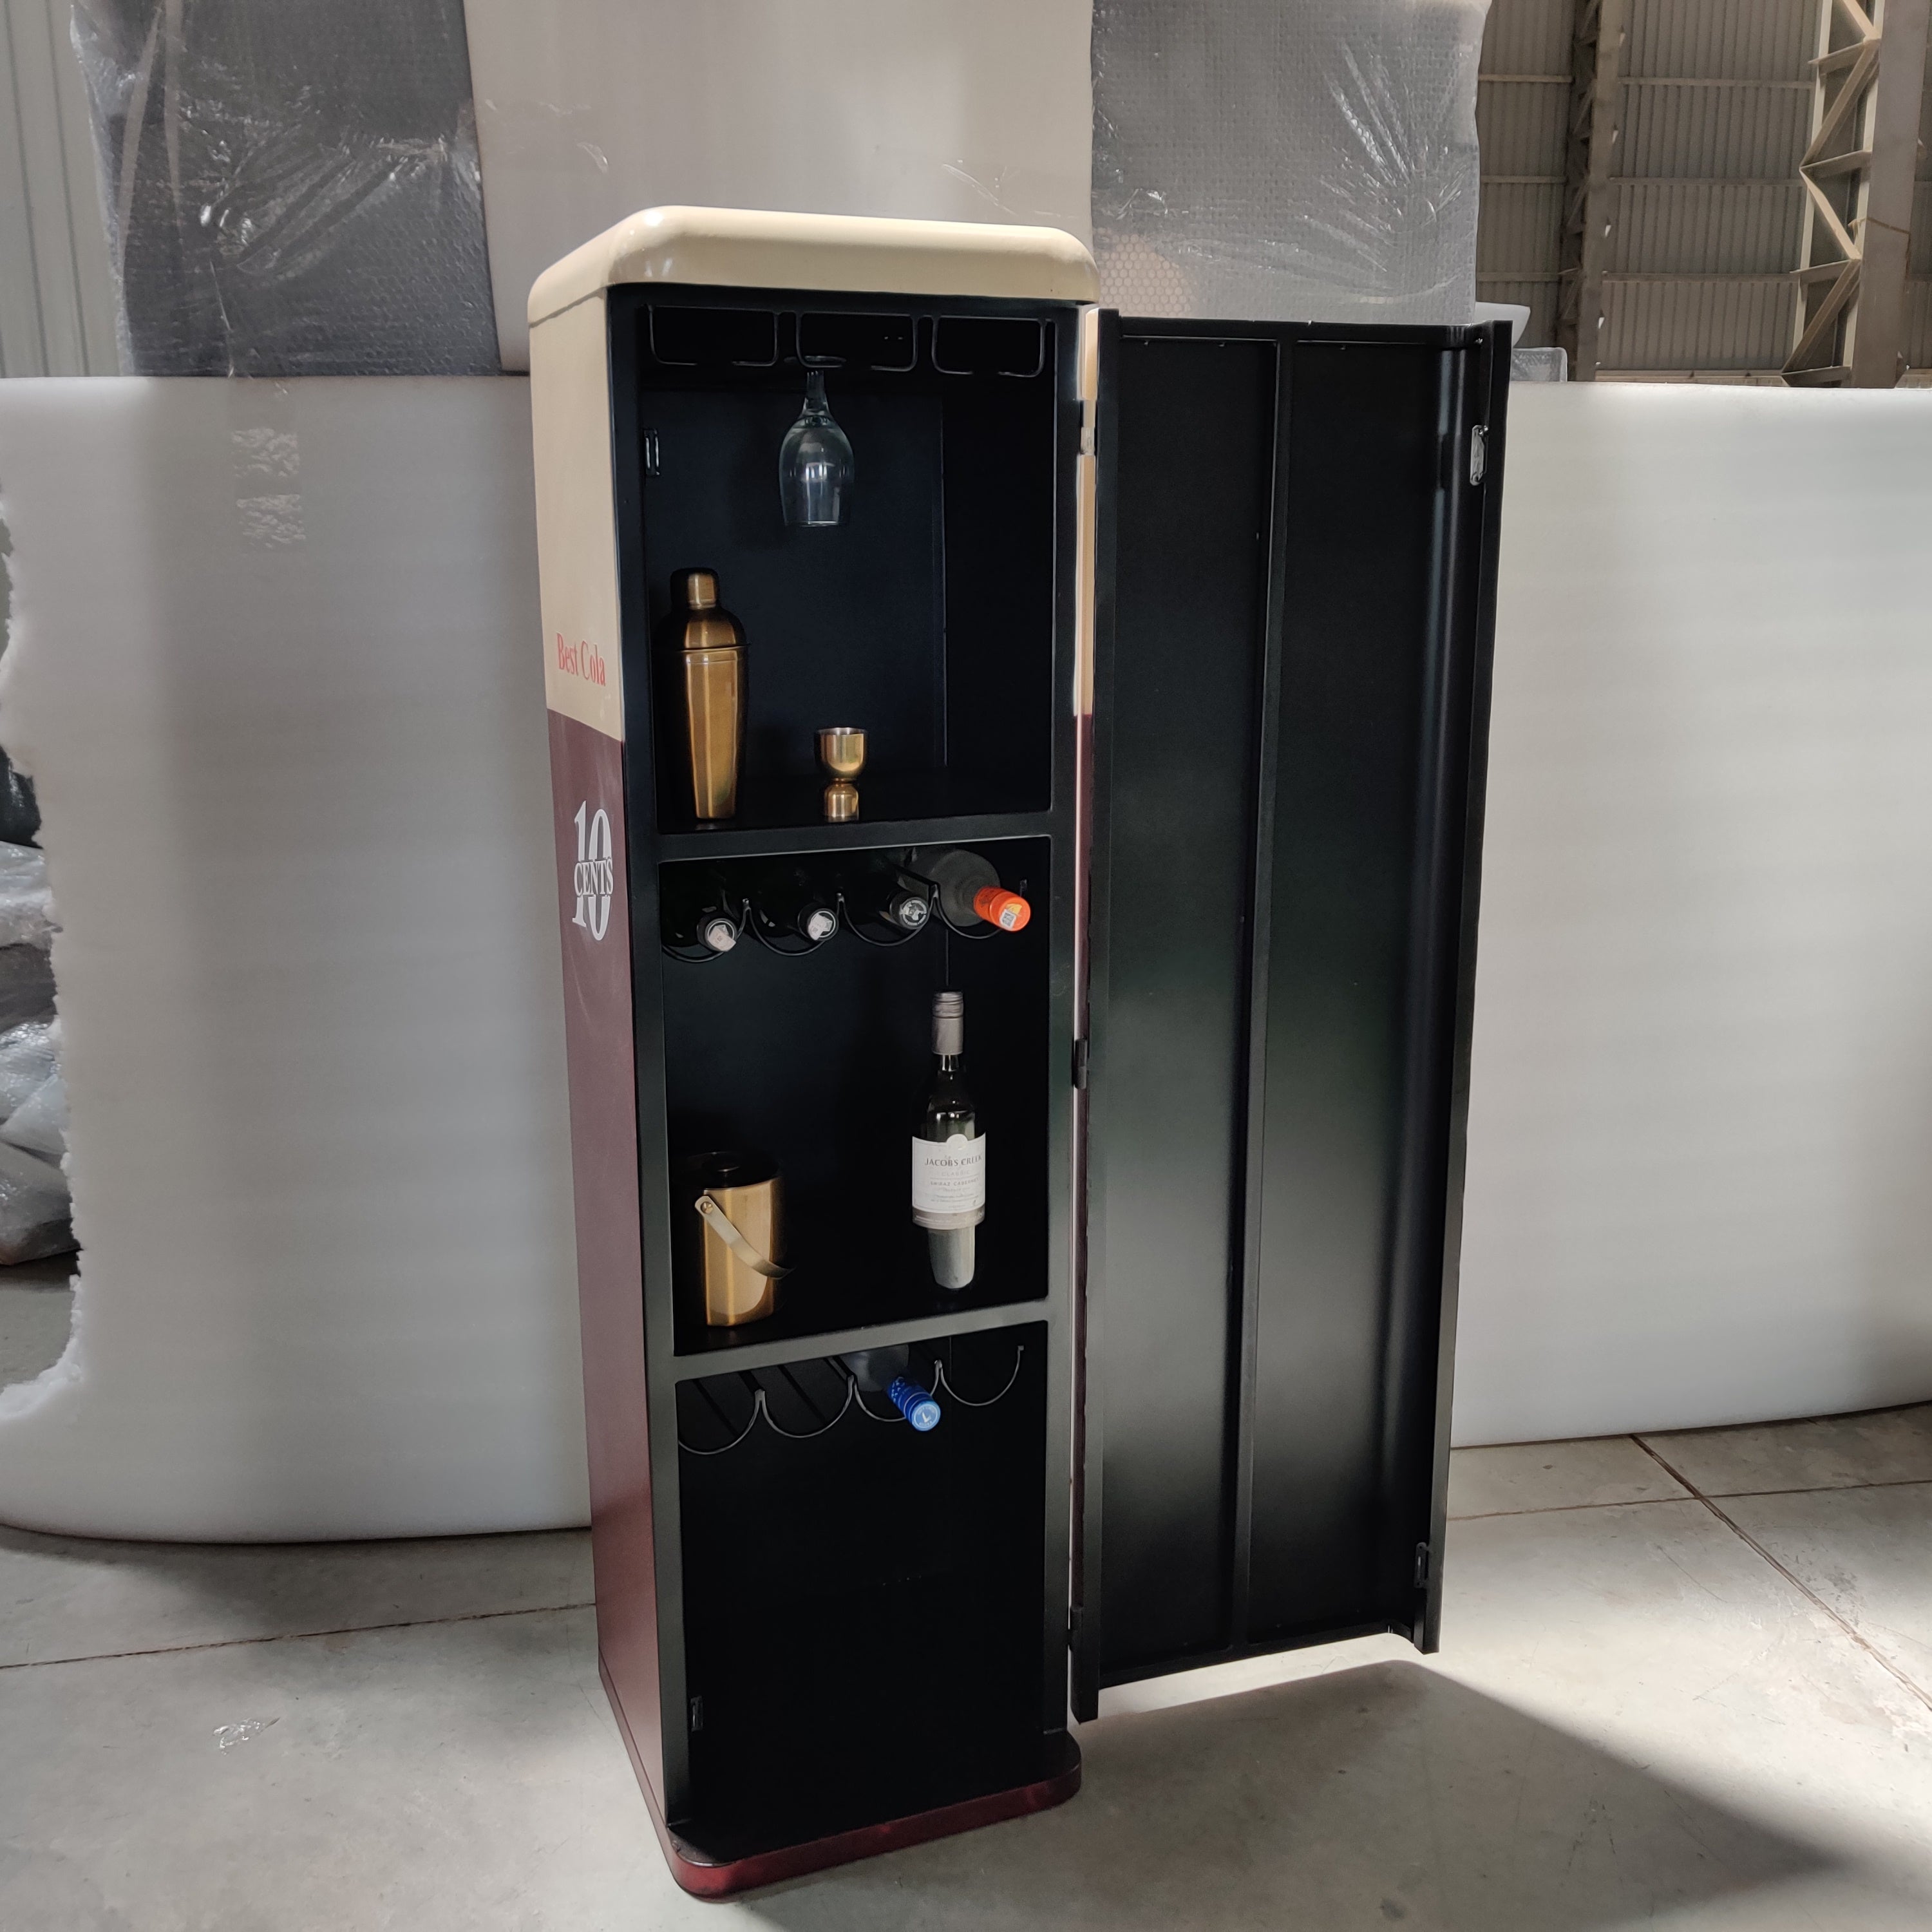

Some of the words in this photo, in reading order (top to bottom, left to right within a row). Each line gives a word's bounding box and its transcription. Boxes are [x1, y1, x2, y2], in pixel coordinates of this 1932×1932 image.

[556, 632, 578, 676] Best
[581, 640, 605, 687] Cola
[574, 858, 613, 896] CENTS
